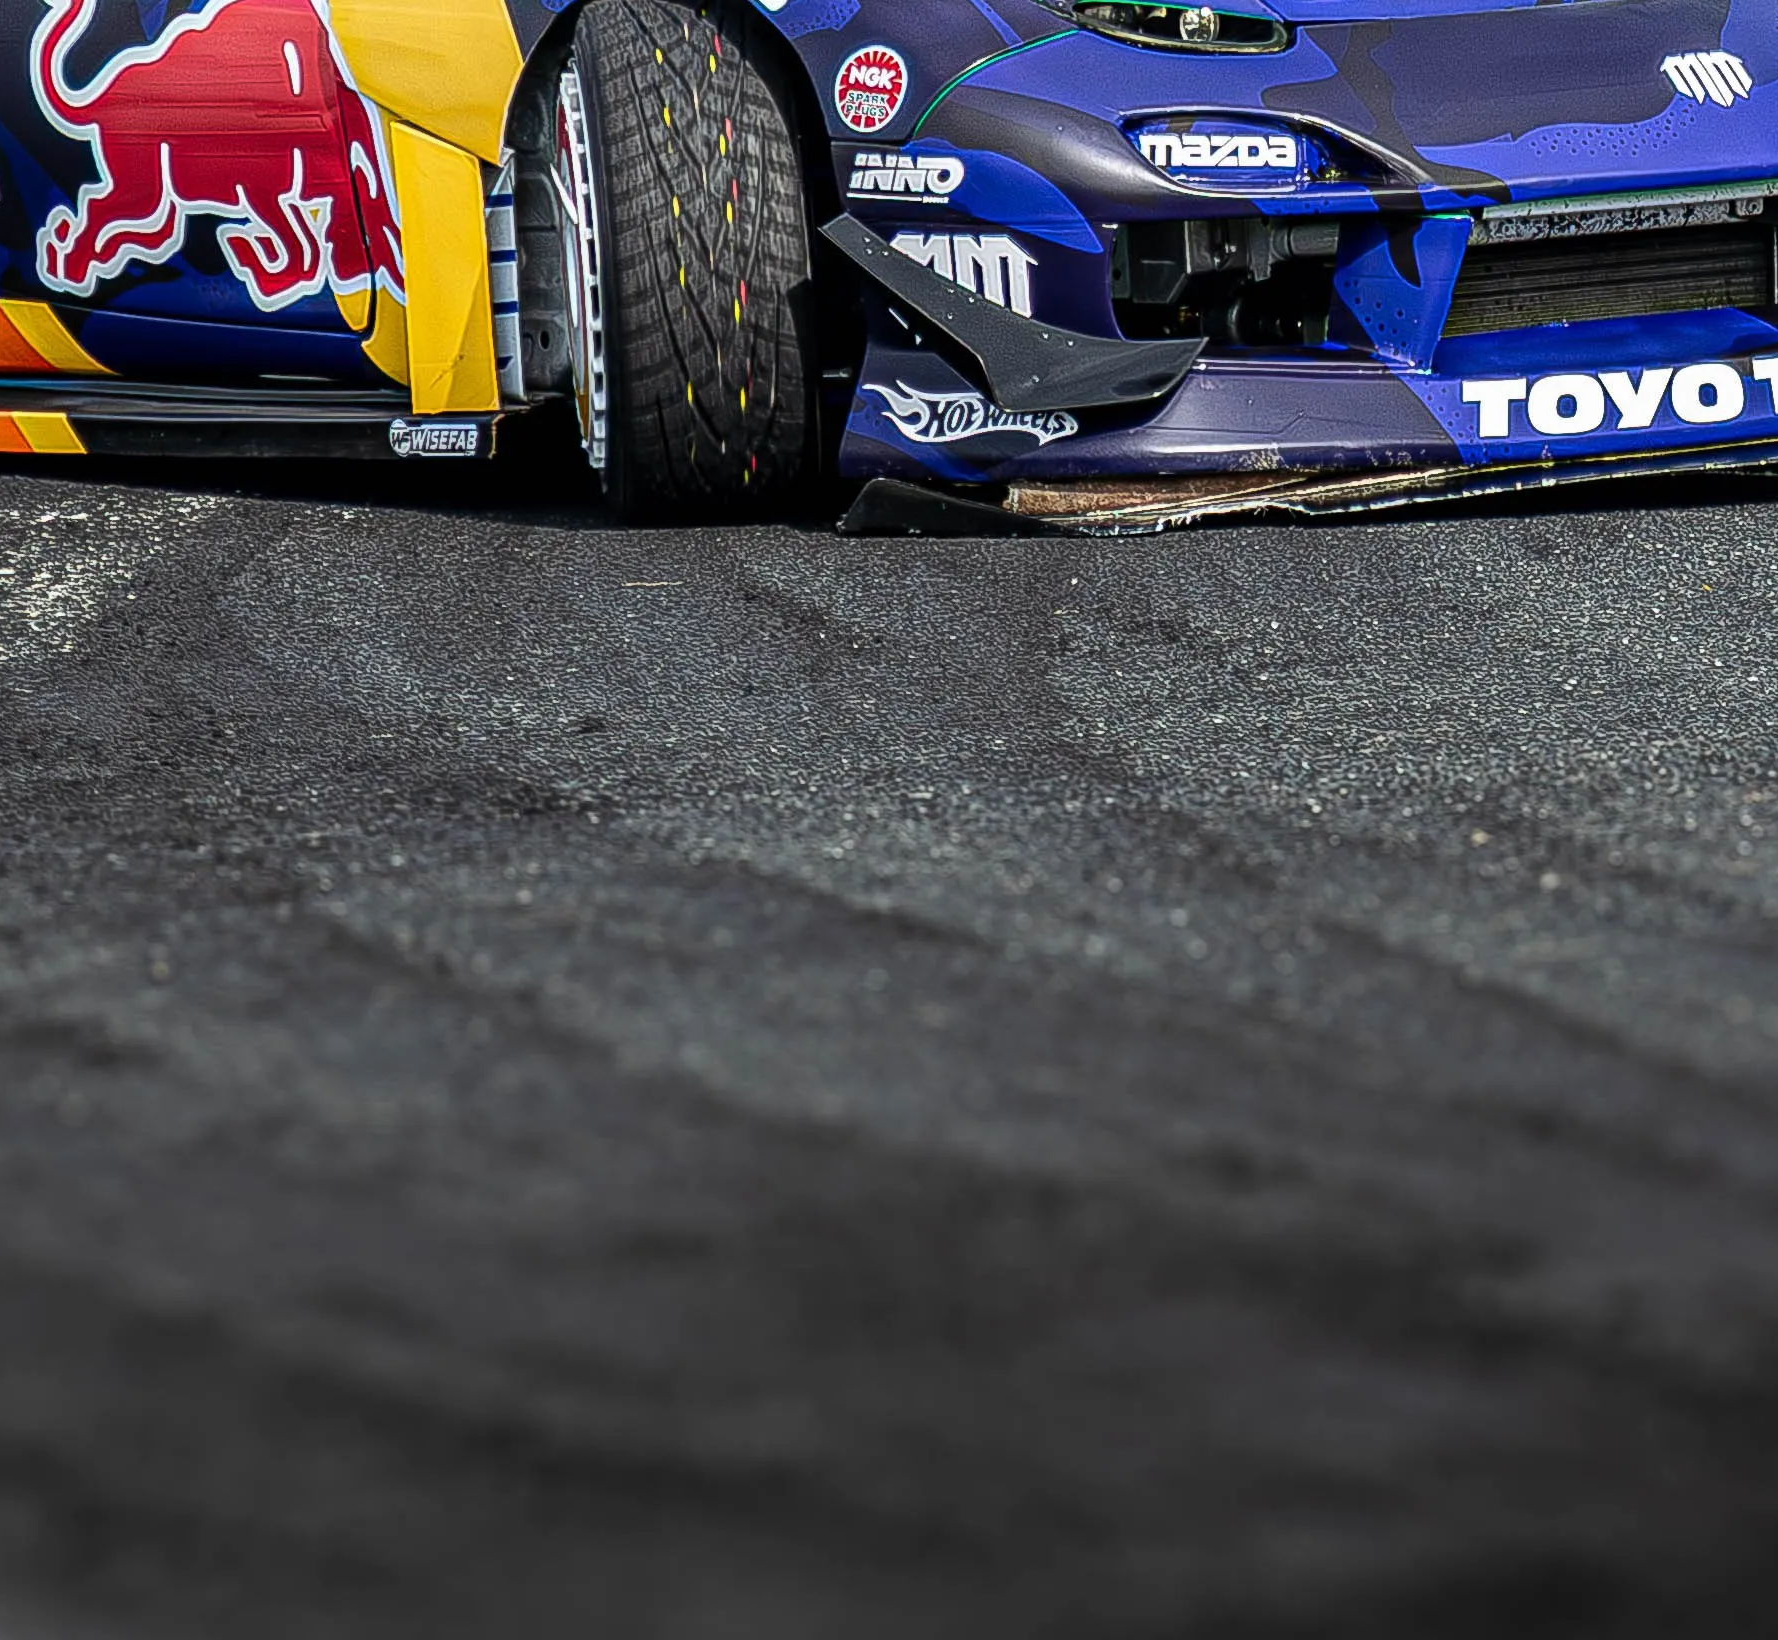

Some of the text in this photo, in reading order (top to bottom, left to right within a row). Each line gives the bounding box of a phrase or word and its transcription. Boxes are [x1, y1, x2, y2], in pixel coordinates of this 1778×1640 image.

[848, 65, 897, 90] NGK
[845, 104, 887, 118] PLUGS
[848, 92, 888, 106] SPARK
[1139, 133, 1297, 168] mazda
[849, 154, 965, 195] INNO
[1463, 364, 1745, 438] TOYO
[411, 429, 479, 450] WISEFAB
